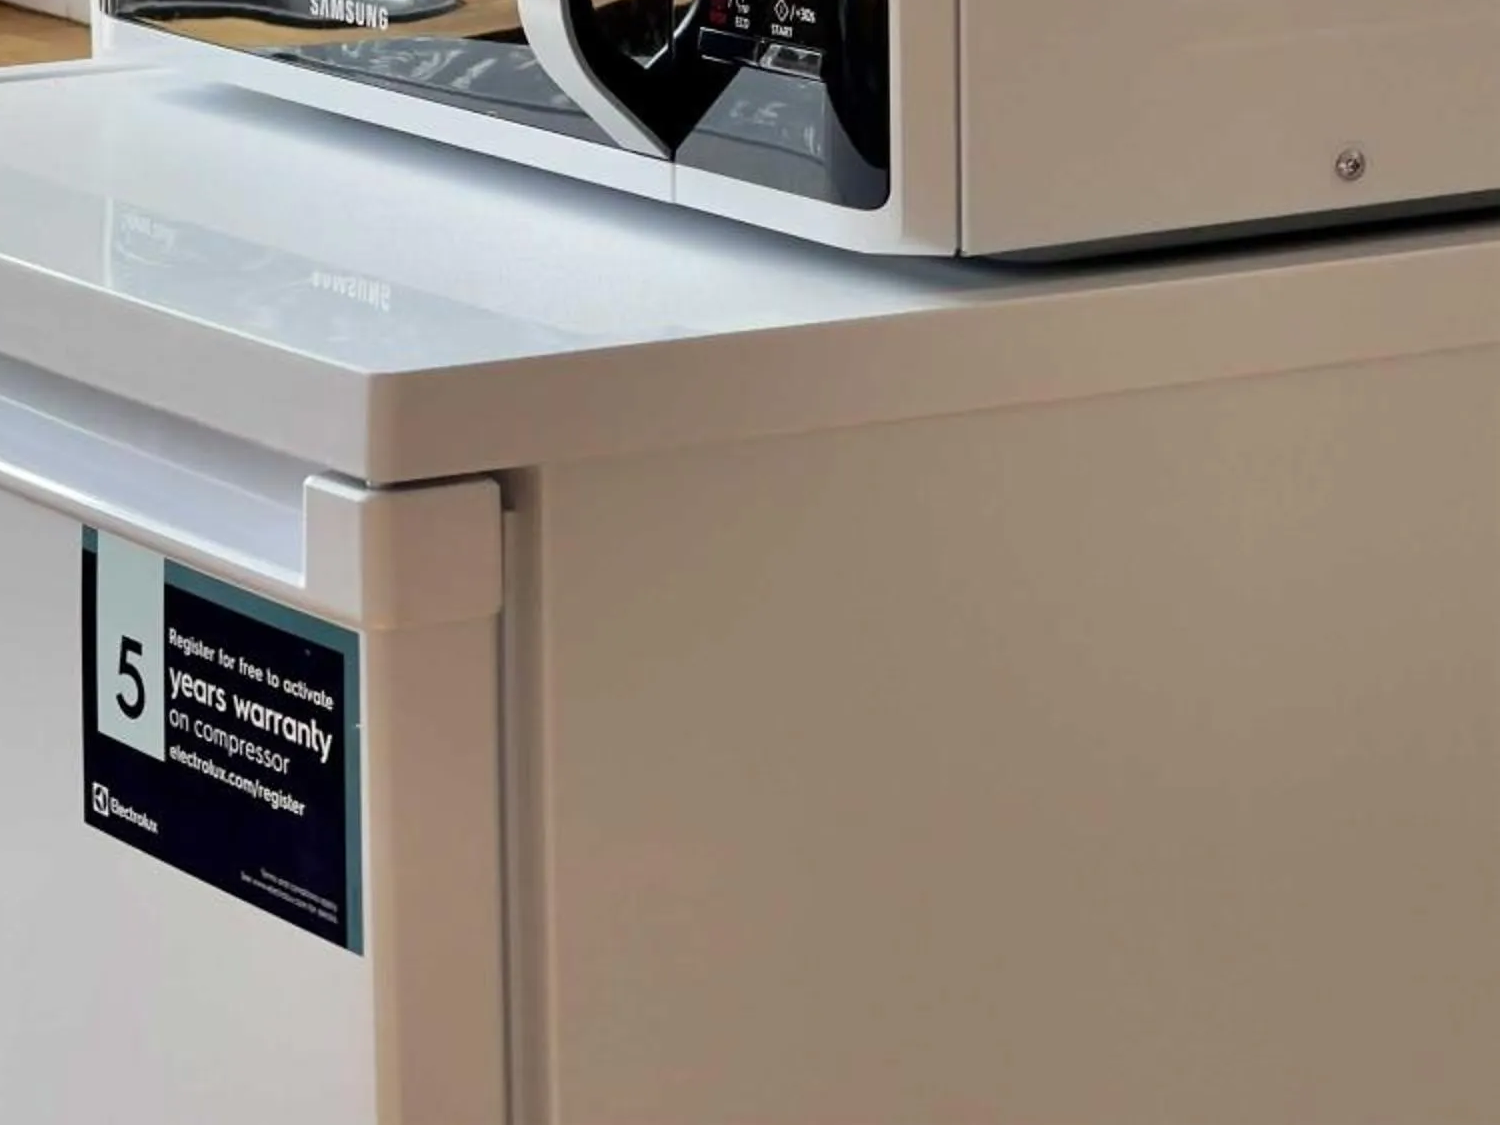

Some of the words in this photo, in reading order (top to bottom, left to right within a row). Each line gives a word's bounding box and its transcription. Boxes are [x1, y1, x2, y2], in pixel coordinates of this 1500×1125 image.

[115, 634, 146, 720] 5
[168, 627, 215, 663] Register
[217, 647, 235, 670] for
[238, 656, 264, 683] free
[266, 666, 279, 689] to
[283, 676, 334, 711] activate
[168, 666, 227, 713] years
[232, 693, 333, 764] warranty
[168, 707, 190, 733] on
[193, 717, 291, 775] compressor
[110, 796, 158, 834] Electrolux
[168, 744, 305, 817] electrolux.com/register
